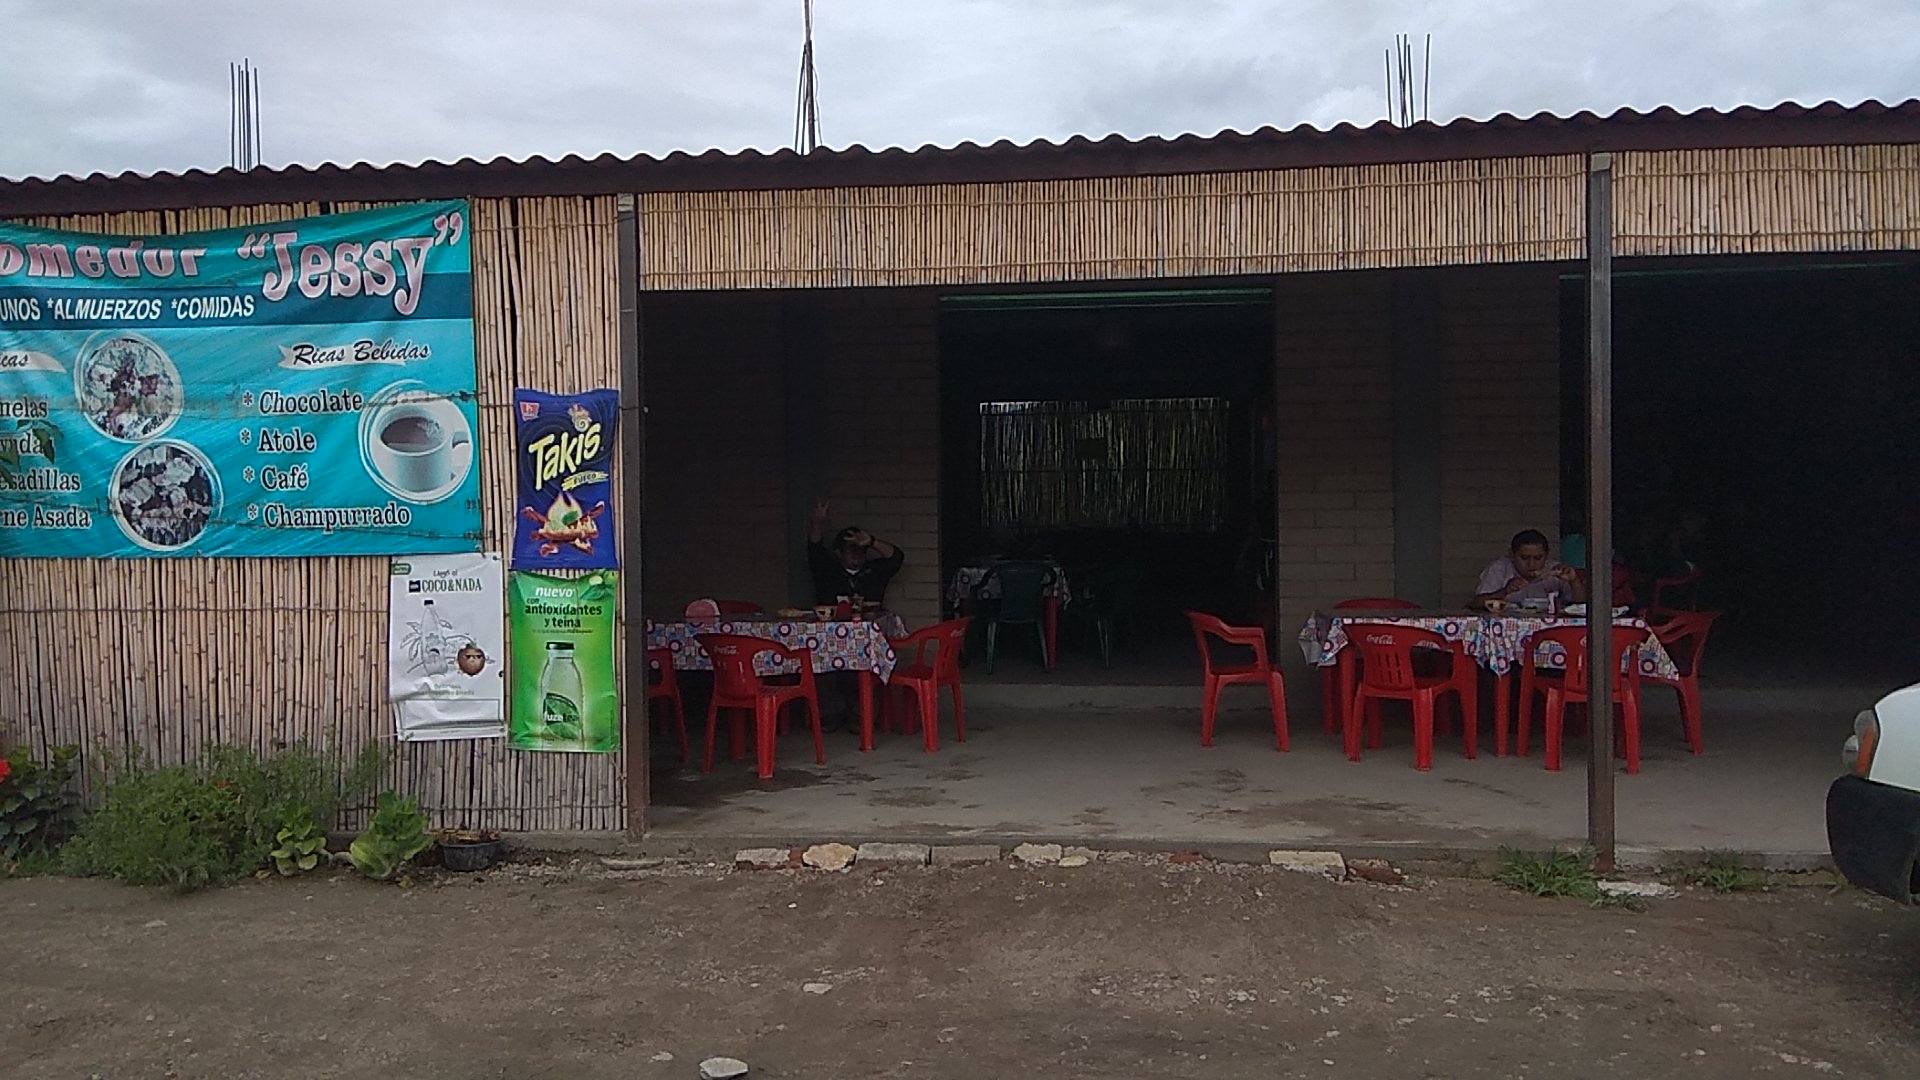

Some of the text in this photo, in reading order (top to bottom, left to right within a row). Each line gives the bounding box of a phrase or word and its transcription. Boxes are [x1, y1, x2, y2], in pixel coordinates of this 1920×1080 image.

[293, 339, 429, 365] Ricas Bebidas
[259, 390, 363, 414] Chocolate
[259, 429, 315, 451] Atole
[261, 465, 308, 490] Café
[33, 505, 91, 528] Asada
[264, 504, 410, 532] Champurrado
[421, 578, 482, 592] COCO&NADA
[535, 586, 574, 598] nuevo
[524, 602, 603, 616] antioxidantes
[526, 597, 540, 605] con
[544, 618, 550, 628] y
